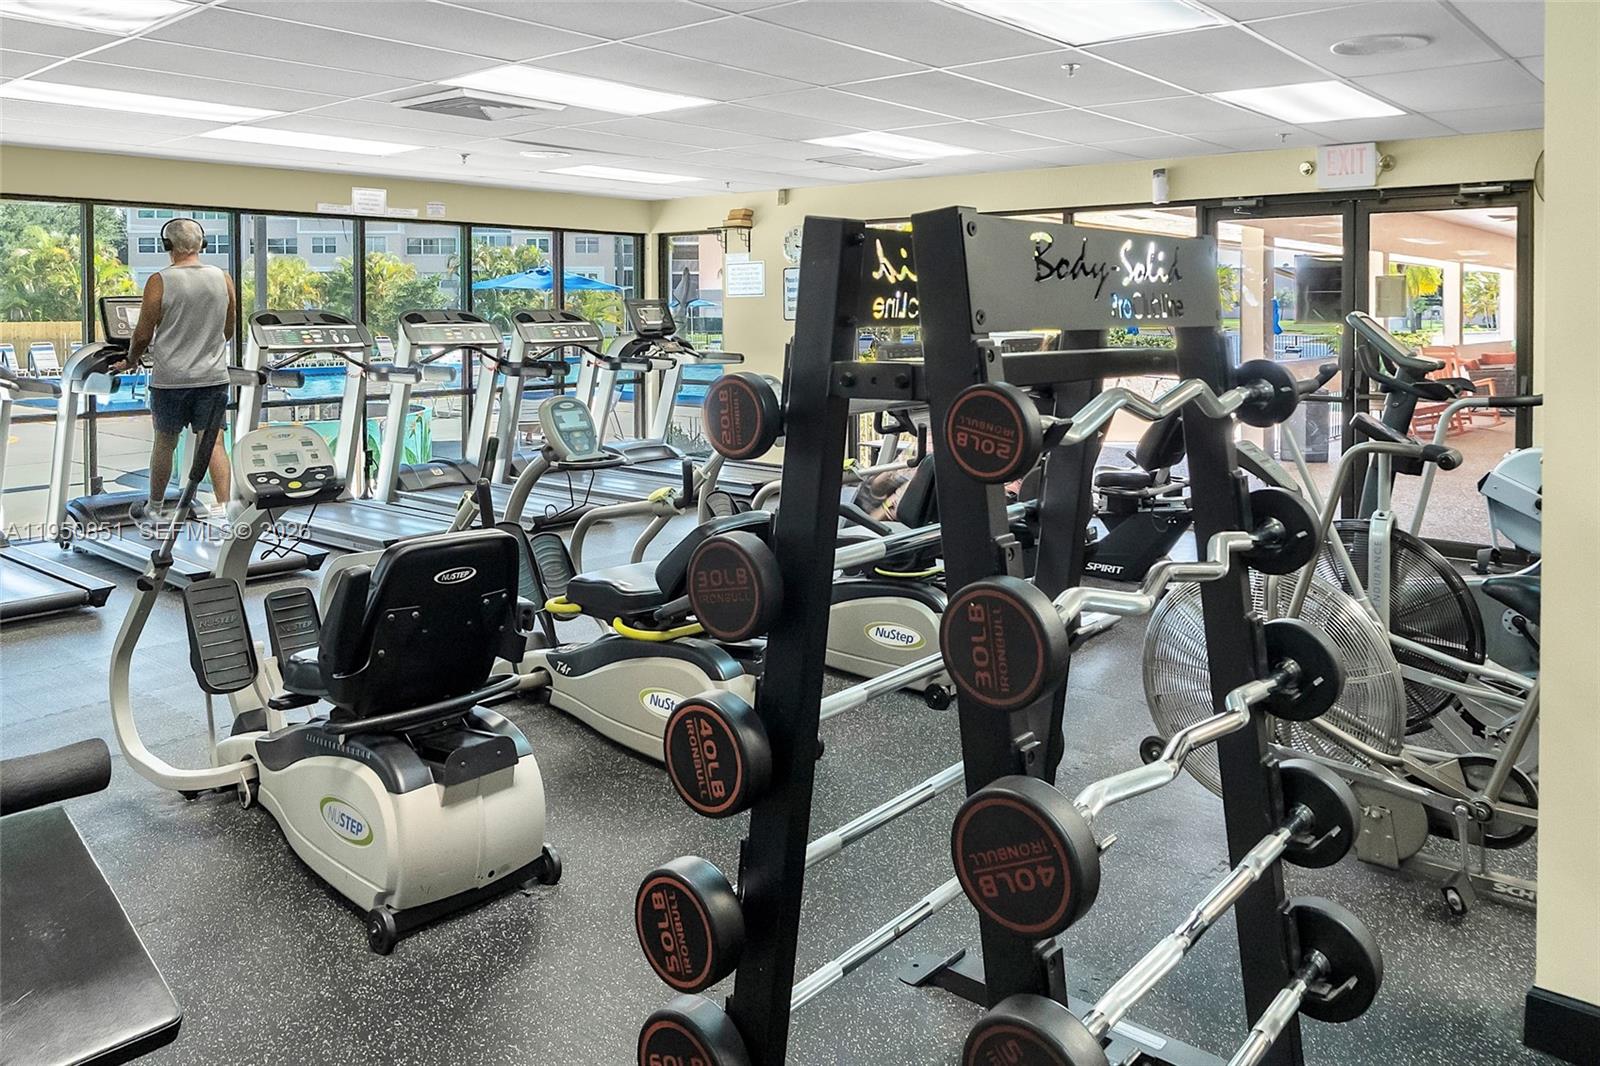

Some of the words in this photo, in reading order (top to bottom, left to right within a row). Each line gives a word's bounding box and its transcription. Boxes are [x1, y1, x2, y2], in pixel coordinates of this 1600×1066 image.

[1327, 147, 1367, 177] EXIT
[1029, 231, 1183, 300] Body-Solid
[718, 389, 732, 446] 20LB
[959, 416, 1016, 438] IRONBULL
[956, 431, 1011, 460] 20LB
[697, 568, 748, 588] 30LB
[1085, 561, 1124, 575] SPIRIT
[875, 627, 914, 645] NuStep
[968, 603, 992, 689] 30LB
[556, 660, 572, 675] T4r
[649, 693, 679, 712] NuSt
[685, 719, 707, 798] IRONBULL
[700, 718, 726, 798] 40LB
[968, 840, 1049, 866] IRONBULL
[978, 864, 1056, 898] 40LB
[1492, 882, 1537, 900] SCH
[652, 892, 681, 973] 50LB
[669, 891, 693, 974] IRONBULL
